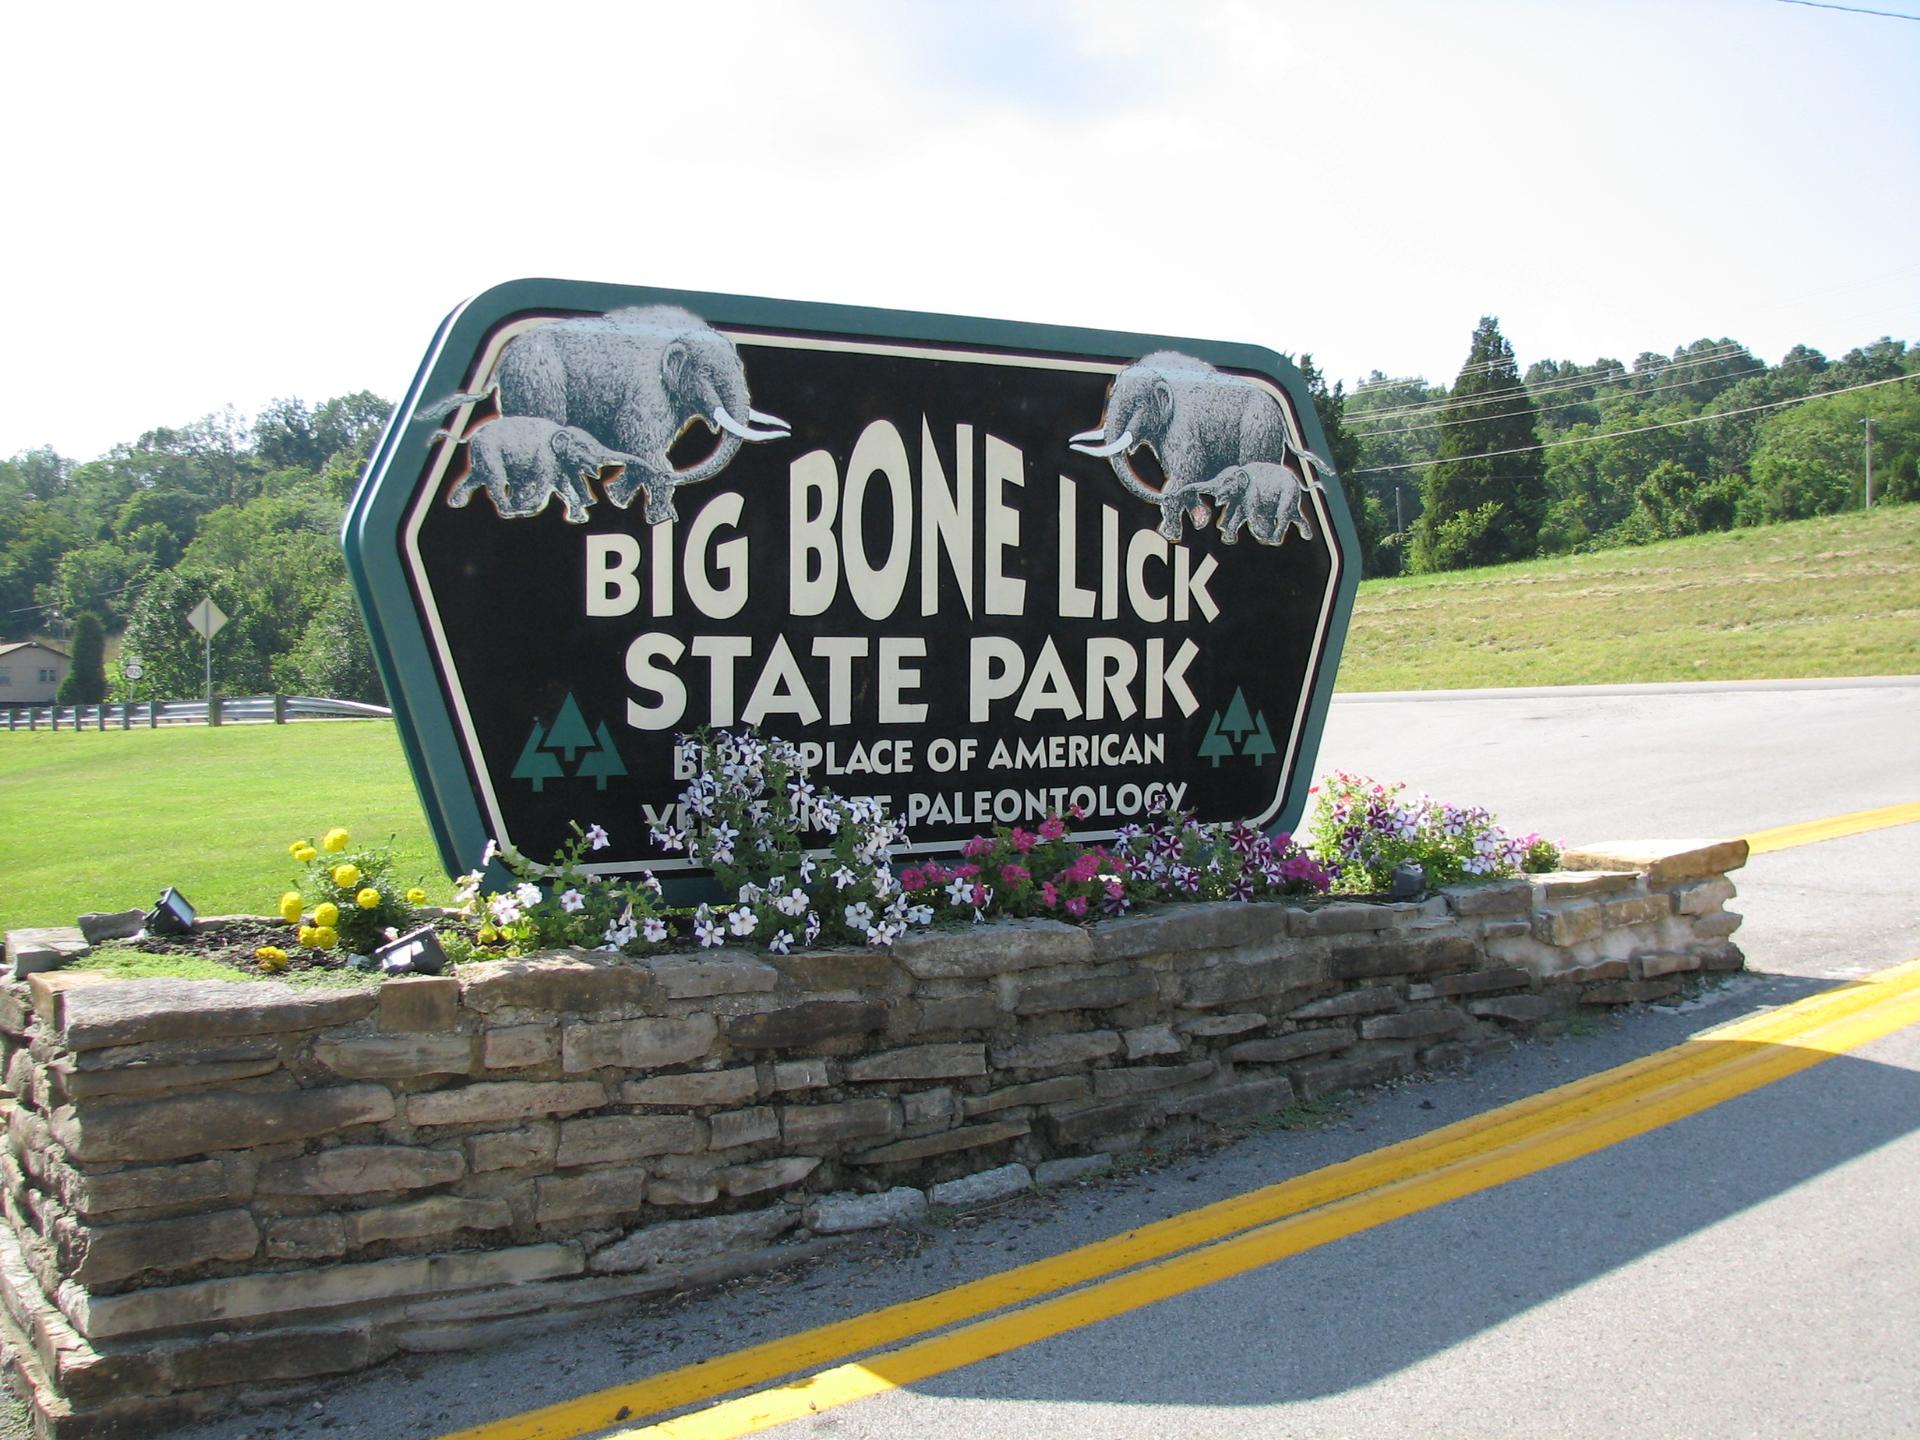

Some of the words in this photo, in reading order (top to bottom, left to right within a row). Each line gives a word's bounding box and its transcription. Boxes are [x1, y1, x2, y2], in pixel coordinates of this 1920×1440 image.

[586, 492, 749, 620] BIG
[789, 412, 1027, 621] BONE
[1059, 475, 1220, 624] LICK
[625, 632, 929, 731] STATE
[970, 634, 1200, 723] PARK
[927, 738, 978, 773] OF
[987, 733, 1165, 770] AMERICAN
[908, 781, 1188, 827] PALEONTOLOGY
